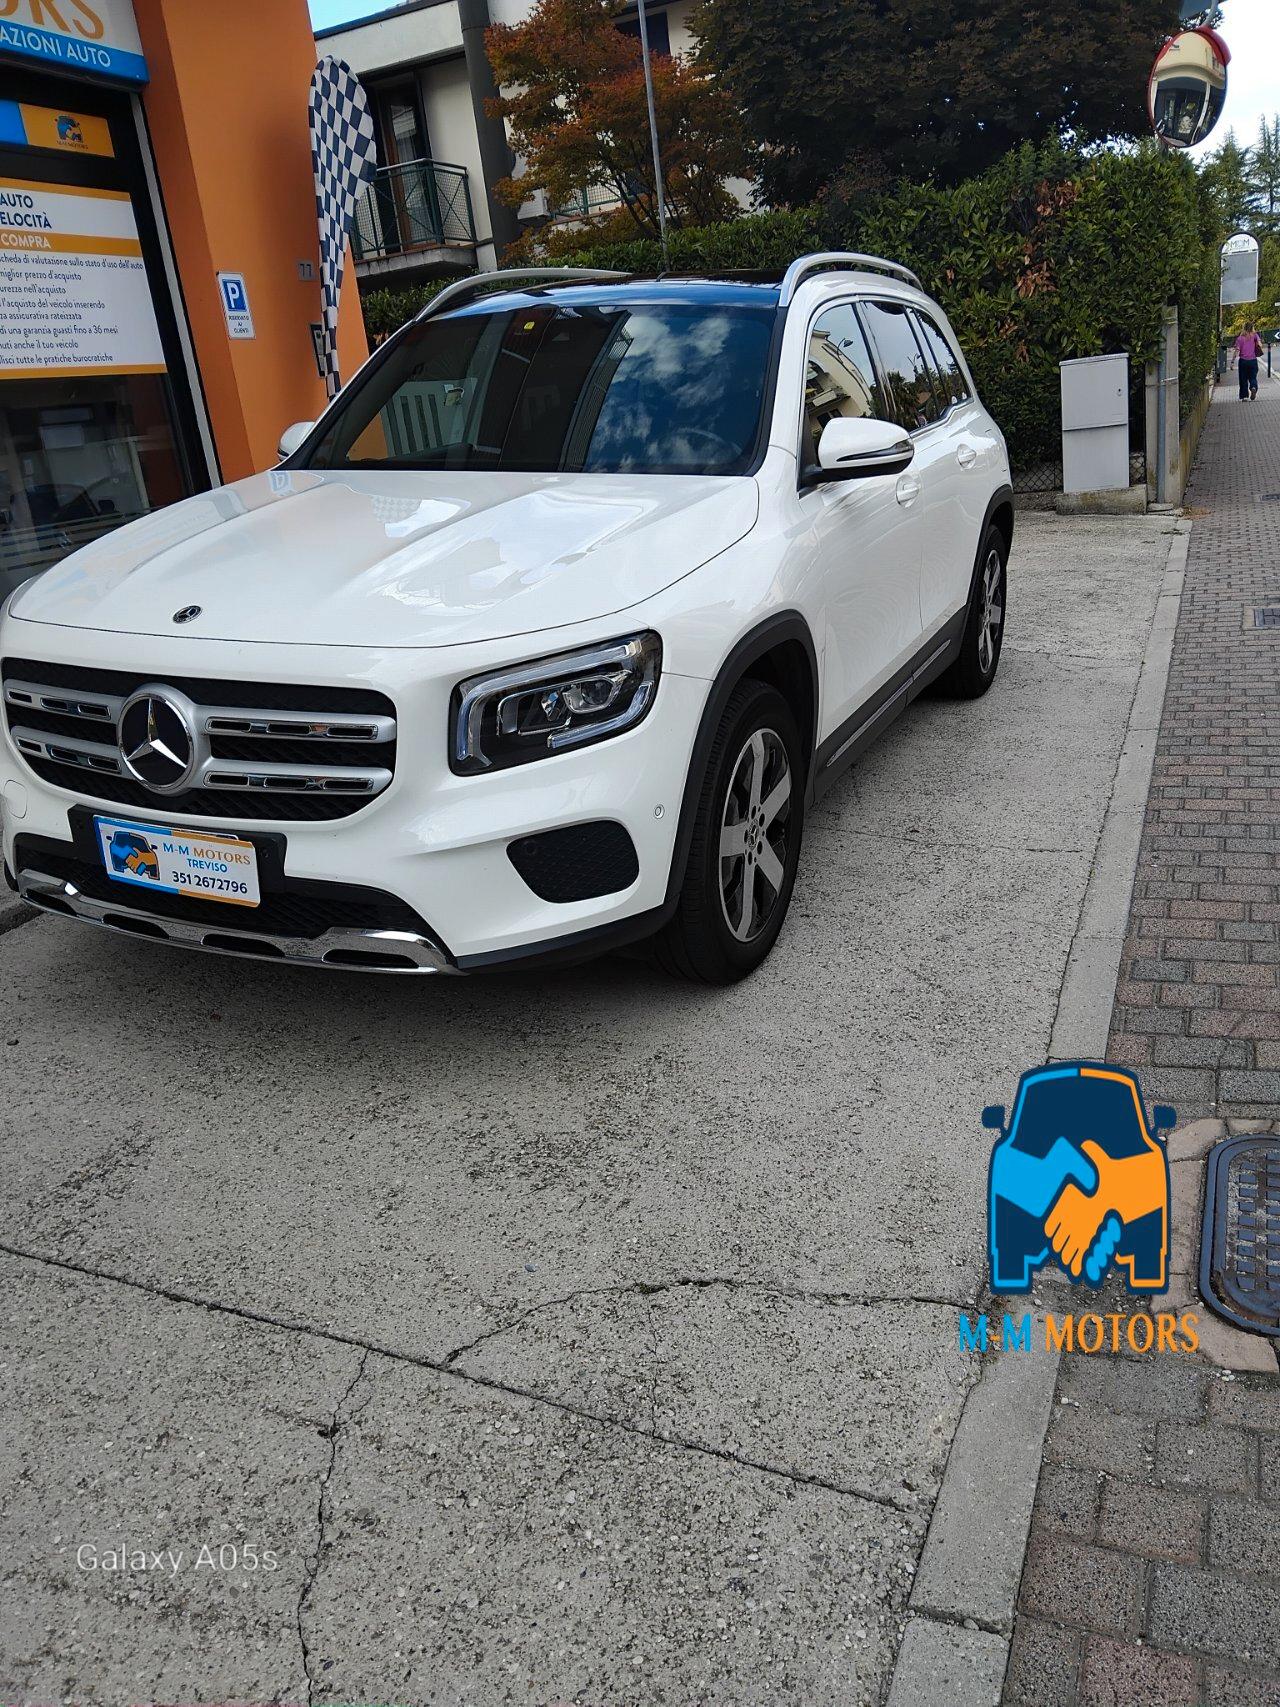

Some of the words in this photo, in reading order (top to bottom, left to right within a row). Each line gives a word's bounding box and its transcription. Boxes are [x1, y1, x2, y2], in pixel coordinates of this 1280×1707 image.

[0, 26, 62, 56] AZIONI
[67, 42, 111, 68] AUTO
[0, 193, 33, 208] AUTO
[1, 233, 51, 248] COMPRA
[0, 253, 21, 263] cheda
[23, 254, 29, 263] di
[31, 255, 68, 265] valutazione
[25, 272, 47, 281] prezzo
[48, 270, 81, 282] d'acquisto
[24, 284, 66, 297] nell'acquisto
[227, 282, 240, 308] P
[38, 299, 48, 307] del
[50, 299, 73, 308] veicolo
[74, 299, 105, 309] inserendo
[9, 311, 49, 319] assicurativa
[51, 311, 82, 319] rateizzata
[24, 325, 51, 338] garanzia
[53, 325, 72, 337] guasti
[74, 325, 87, 334] fino
[93, 325, 102, 334] 36
[104, 325, 118, 334] mesi
[14, 340, 35, 349] anche
[36, 340, 40, 348] il
[56, 339, 78, 349] veicolo
[35, 354, 42, 363] le
[44, 354, 71, 366] pratiche
[72, 353, 113, 362] burocratiche
[163, 843, 189, 855] M-M
[193, 847, 251, 865] MOTORS
[187, 858, 228, 873] TREVISO
